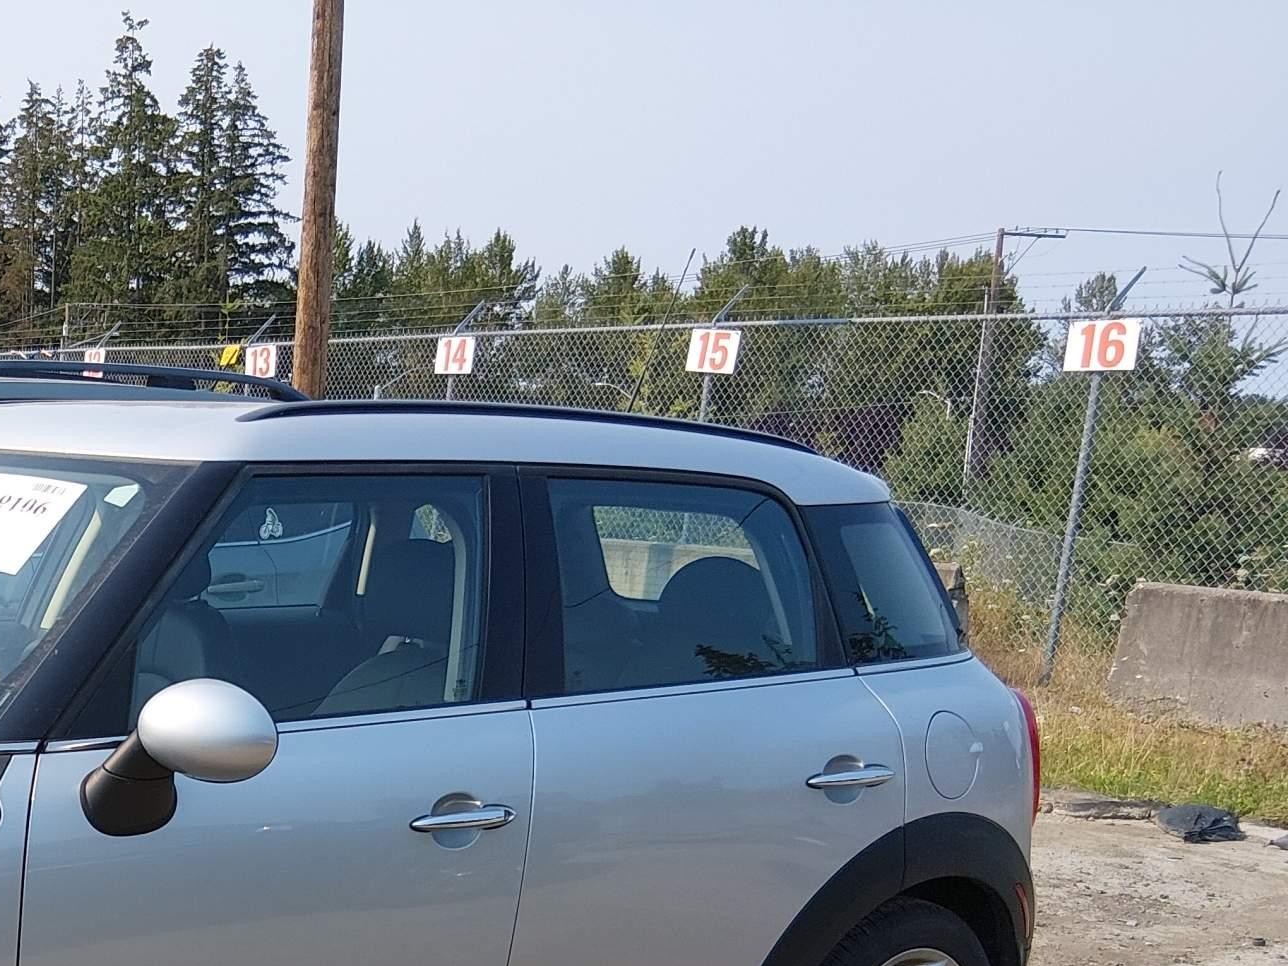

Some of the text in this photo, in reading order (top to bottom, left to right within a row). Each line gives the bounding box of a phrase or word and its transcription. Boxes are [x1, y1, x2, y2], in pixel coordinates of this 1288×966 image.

[251, 347, 270, 376] 13
[443, 338, 467, 371] 14
[697, 331, 731, 370] 15
[1080, 321, 1127, 368] 16
